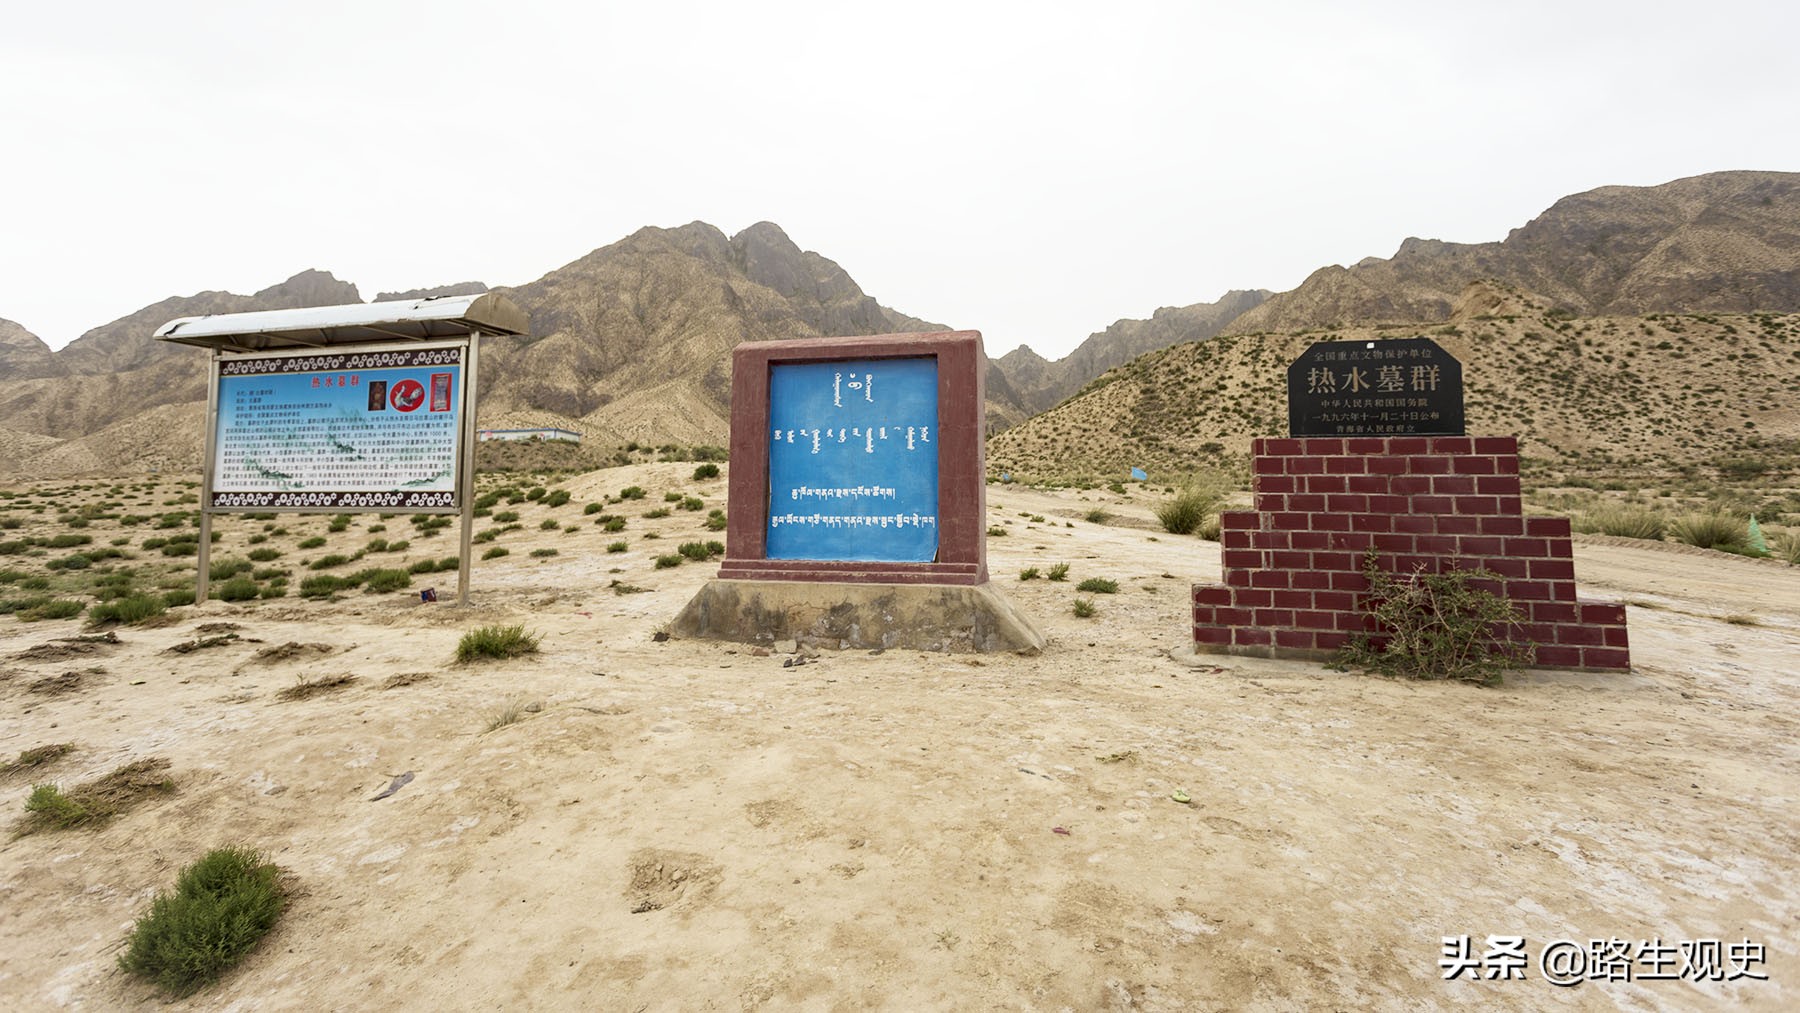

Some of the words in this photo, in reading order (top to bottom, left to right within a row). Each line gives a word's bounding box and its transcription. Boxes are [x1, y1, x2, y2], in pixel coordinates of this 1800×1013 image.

[1314, 348, 1433, 362] 全国重点文物保护单位
[1307, 364, 1441, 394] 热水墓群
[1320, 397, 1429, 408] 中华人民共和国国务院
[1312, 411, 1440, 422] 一九九六年十一月二十日公布
[1336, 425, 1416, 433] 青海省人民政府立
